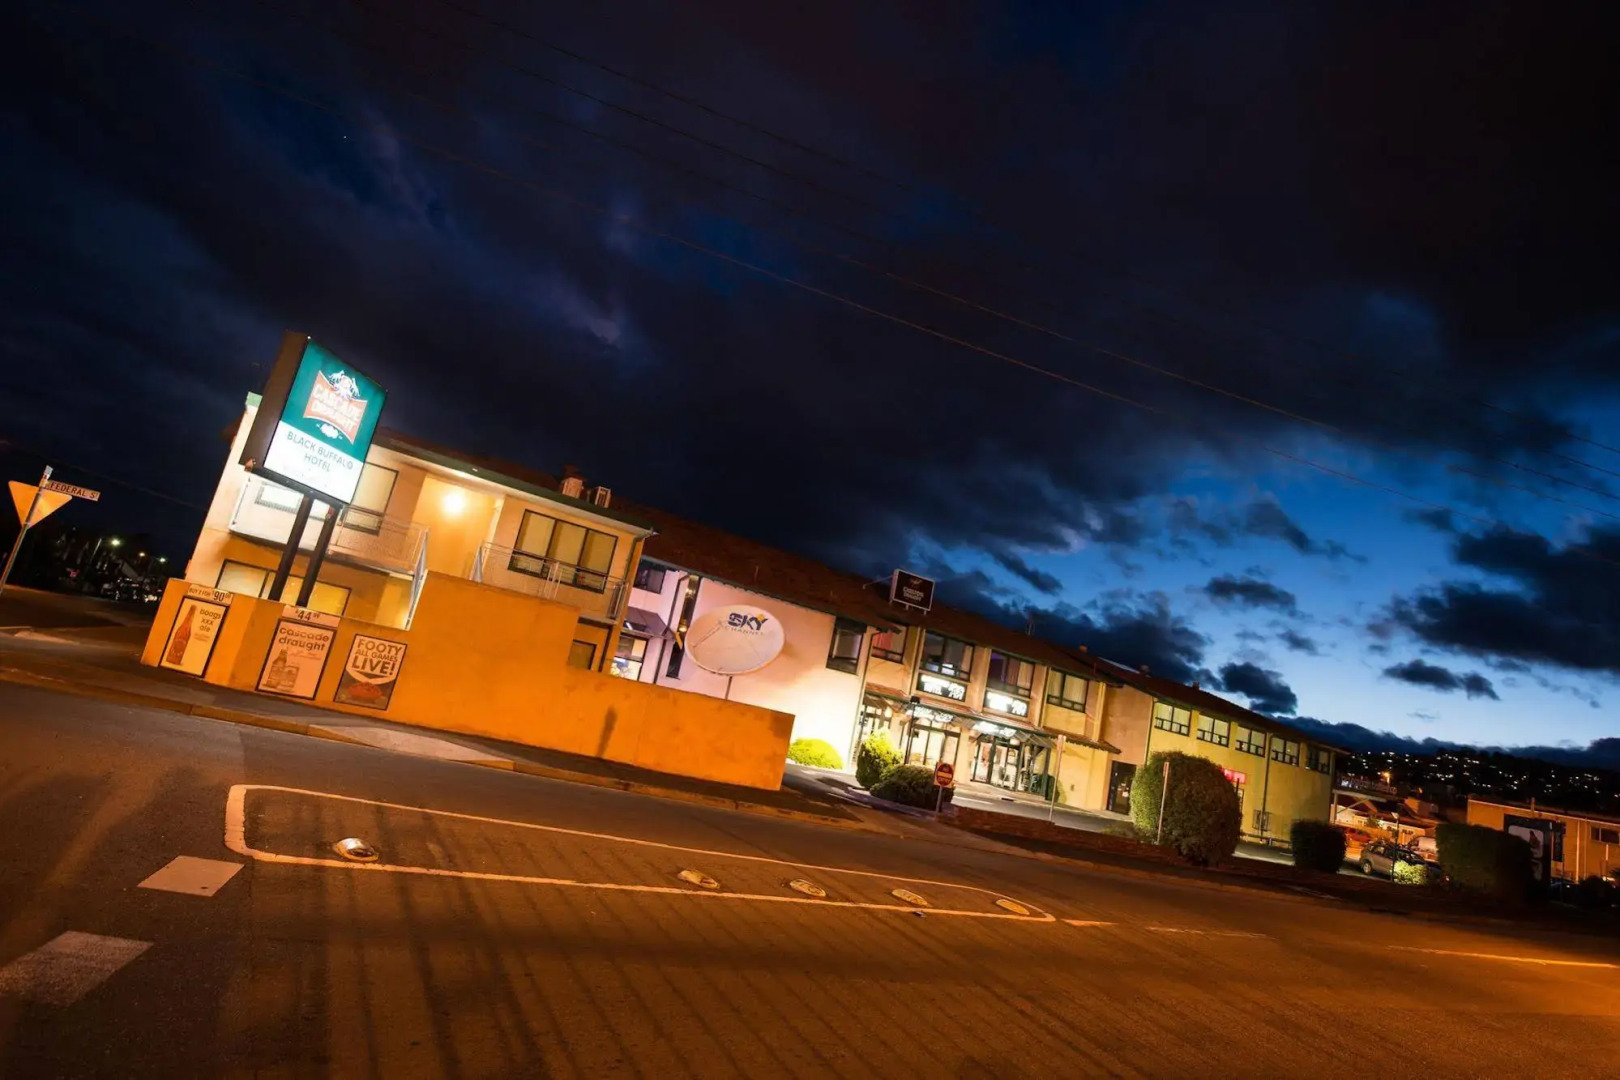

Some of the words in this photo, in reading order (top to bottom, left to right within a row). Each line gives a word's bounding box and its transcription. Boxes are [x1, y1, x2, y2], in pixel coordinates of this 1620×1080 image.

[286, 431, 316, 451] BLACK
[317, 446, 353, 470] BUFFALO
[304, 453, 331, 472] HOTEL
[50, 482, 88, 497] FEDERAL
[728, 612, 768, 631] SKY
[279, 627, 330, 642] cascade
[278, 636, 326, 652] draught
[357, 638, 403, 656] FOOTY
[355, 649, 369, 658] ALL
[371, 651, 398, 663] GAMES
[351, 655, 396, 676] LIVE!
